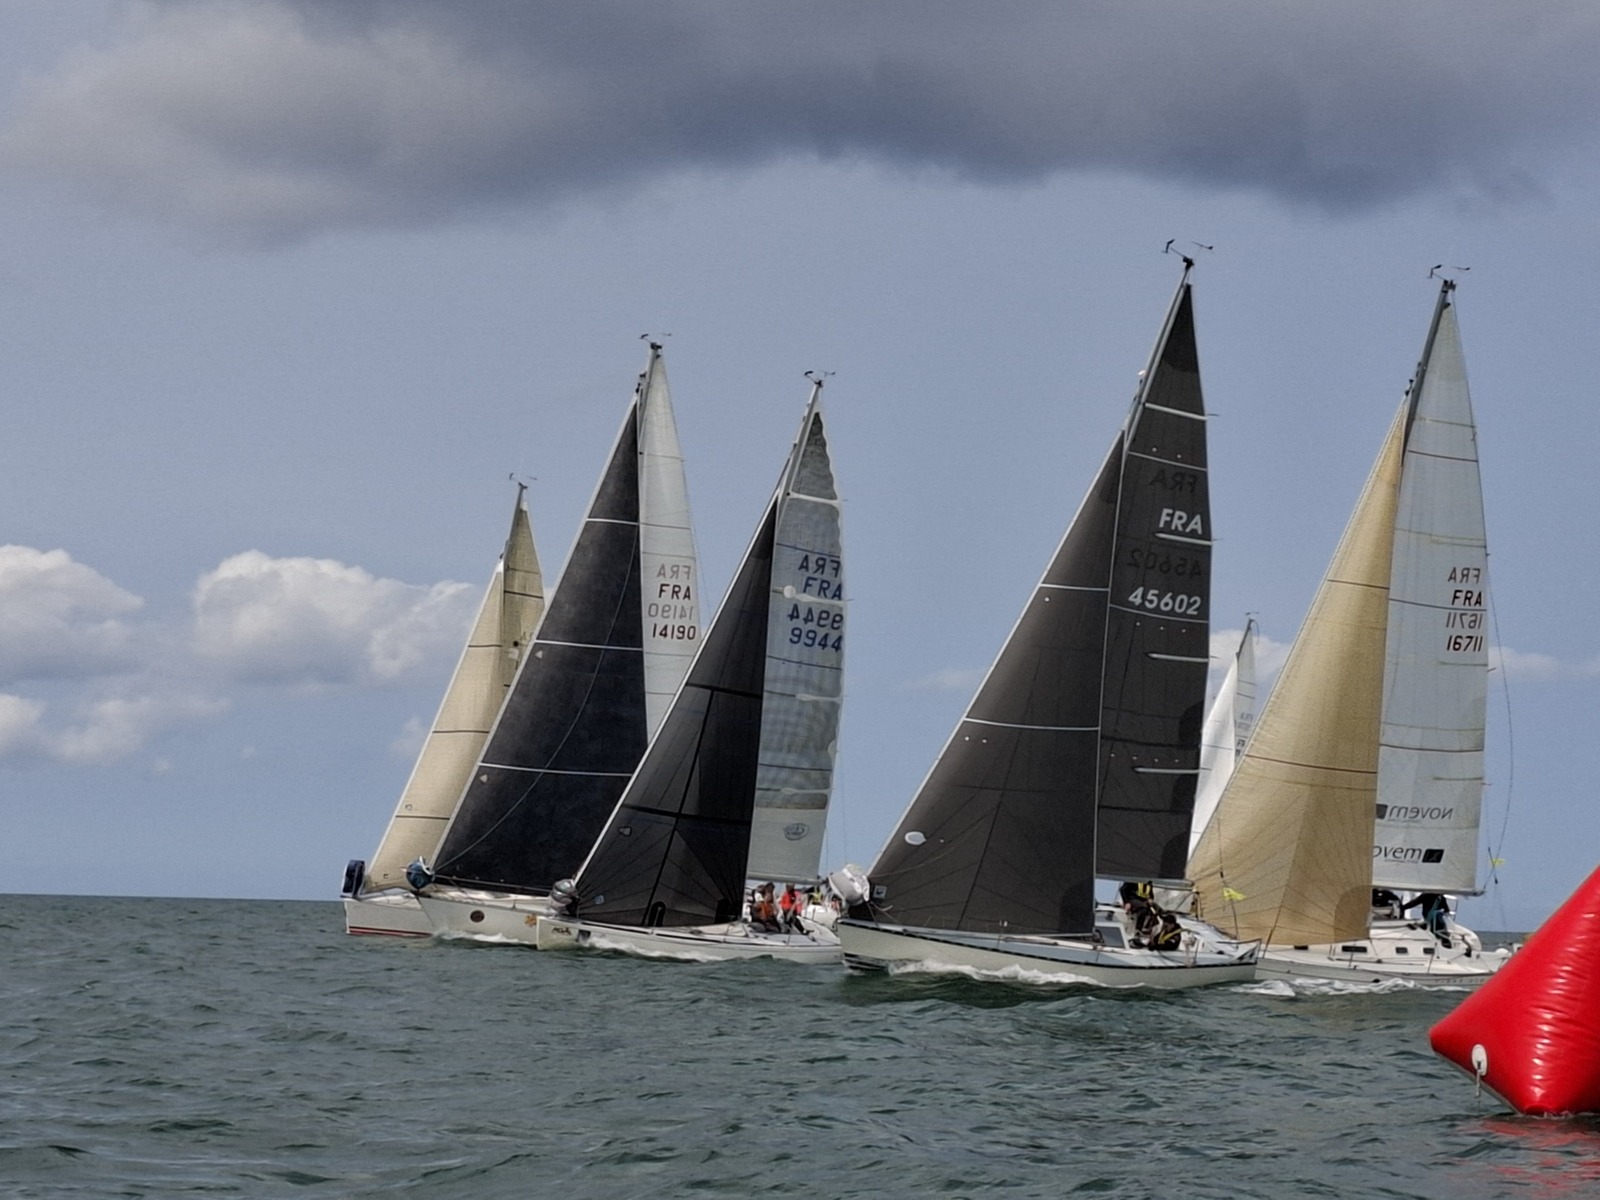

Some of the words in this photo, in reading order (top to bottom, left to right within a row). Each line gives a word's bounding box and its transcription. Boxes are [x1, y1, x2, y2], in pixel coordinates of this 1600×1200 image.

[1159, 508, 1203, 535] FRA
[658, 583, 691, 600] FRA
[803, 576, 842, 600] FRA
[1128, 586, 1201, 615] 45602
[1451, 589, 1482, 606] FRA
[652, 622, 696, 640] 14190
[789, 627, 843, 652] 9944
[1446, 635, 1483, 652] 16711
[1373, 846, 1422, 861] ovem
